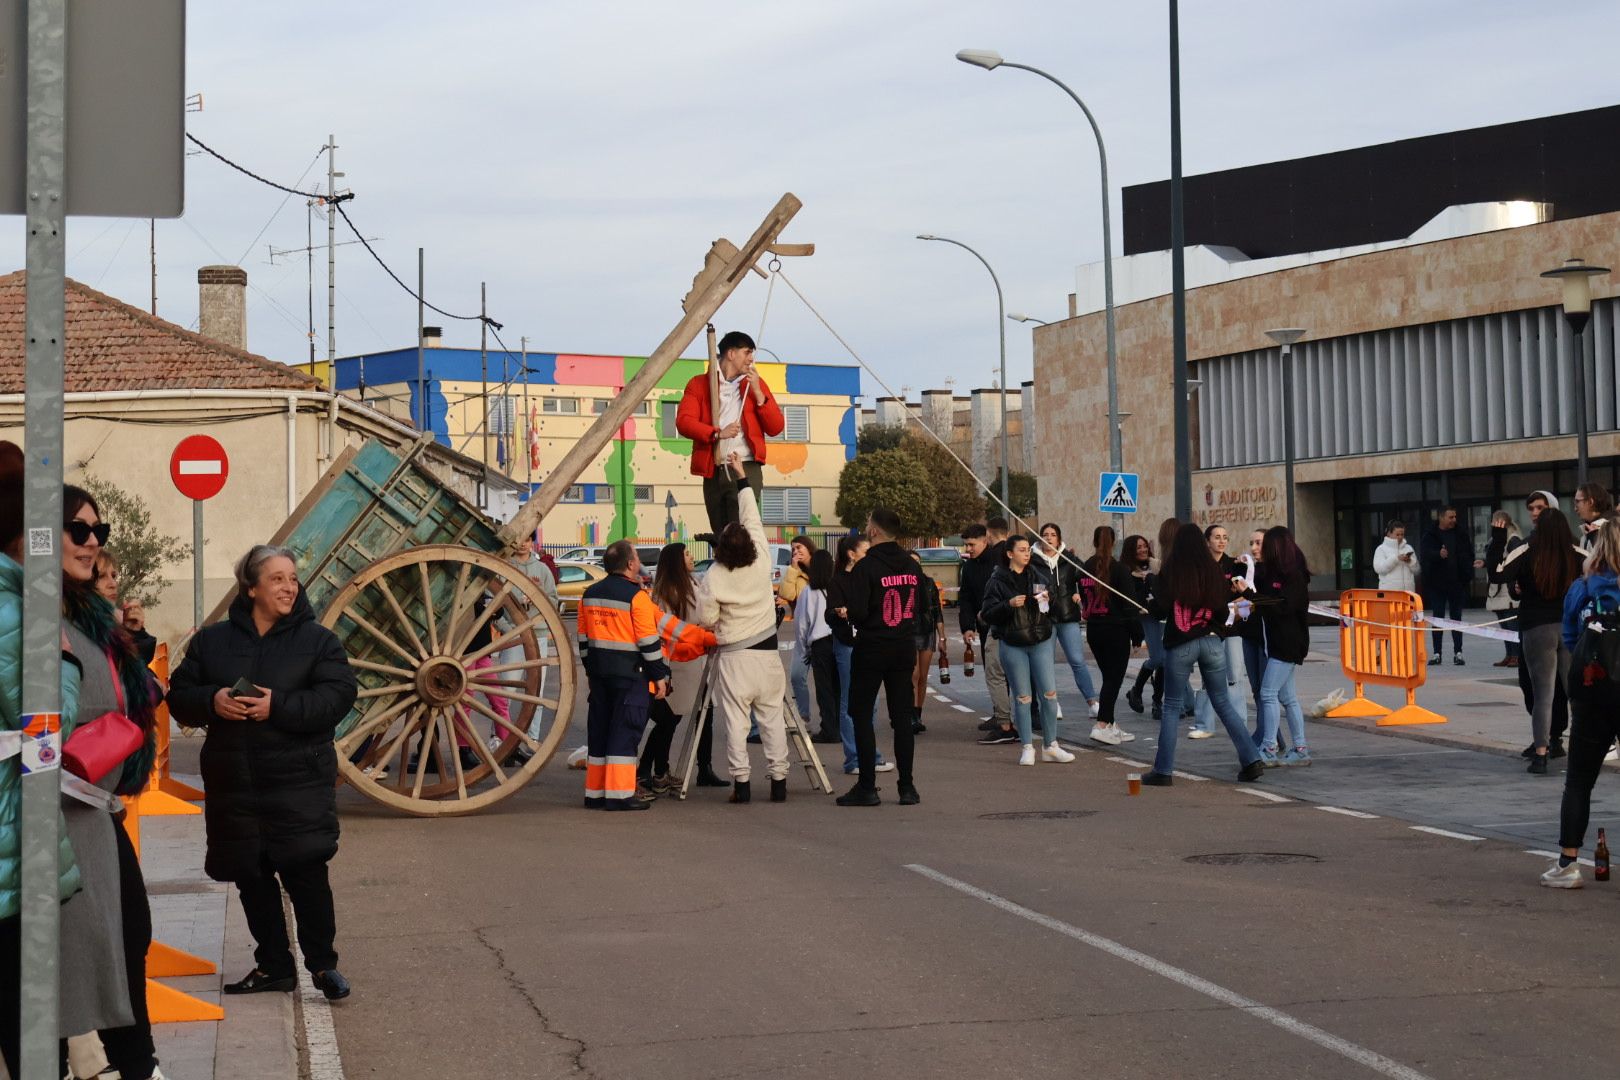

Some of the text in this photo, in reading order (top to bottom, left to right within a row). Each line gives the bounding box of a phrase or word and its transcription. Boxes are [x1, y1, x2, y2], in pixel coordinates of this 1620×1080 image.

[1219, 486, 1277, 506] AUDITORIO
[1208, 504, 1276, 524] BERENGUELA
[881, 574, 918, 587] QUINTOS
